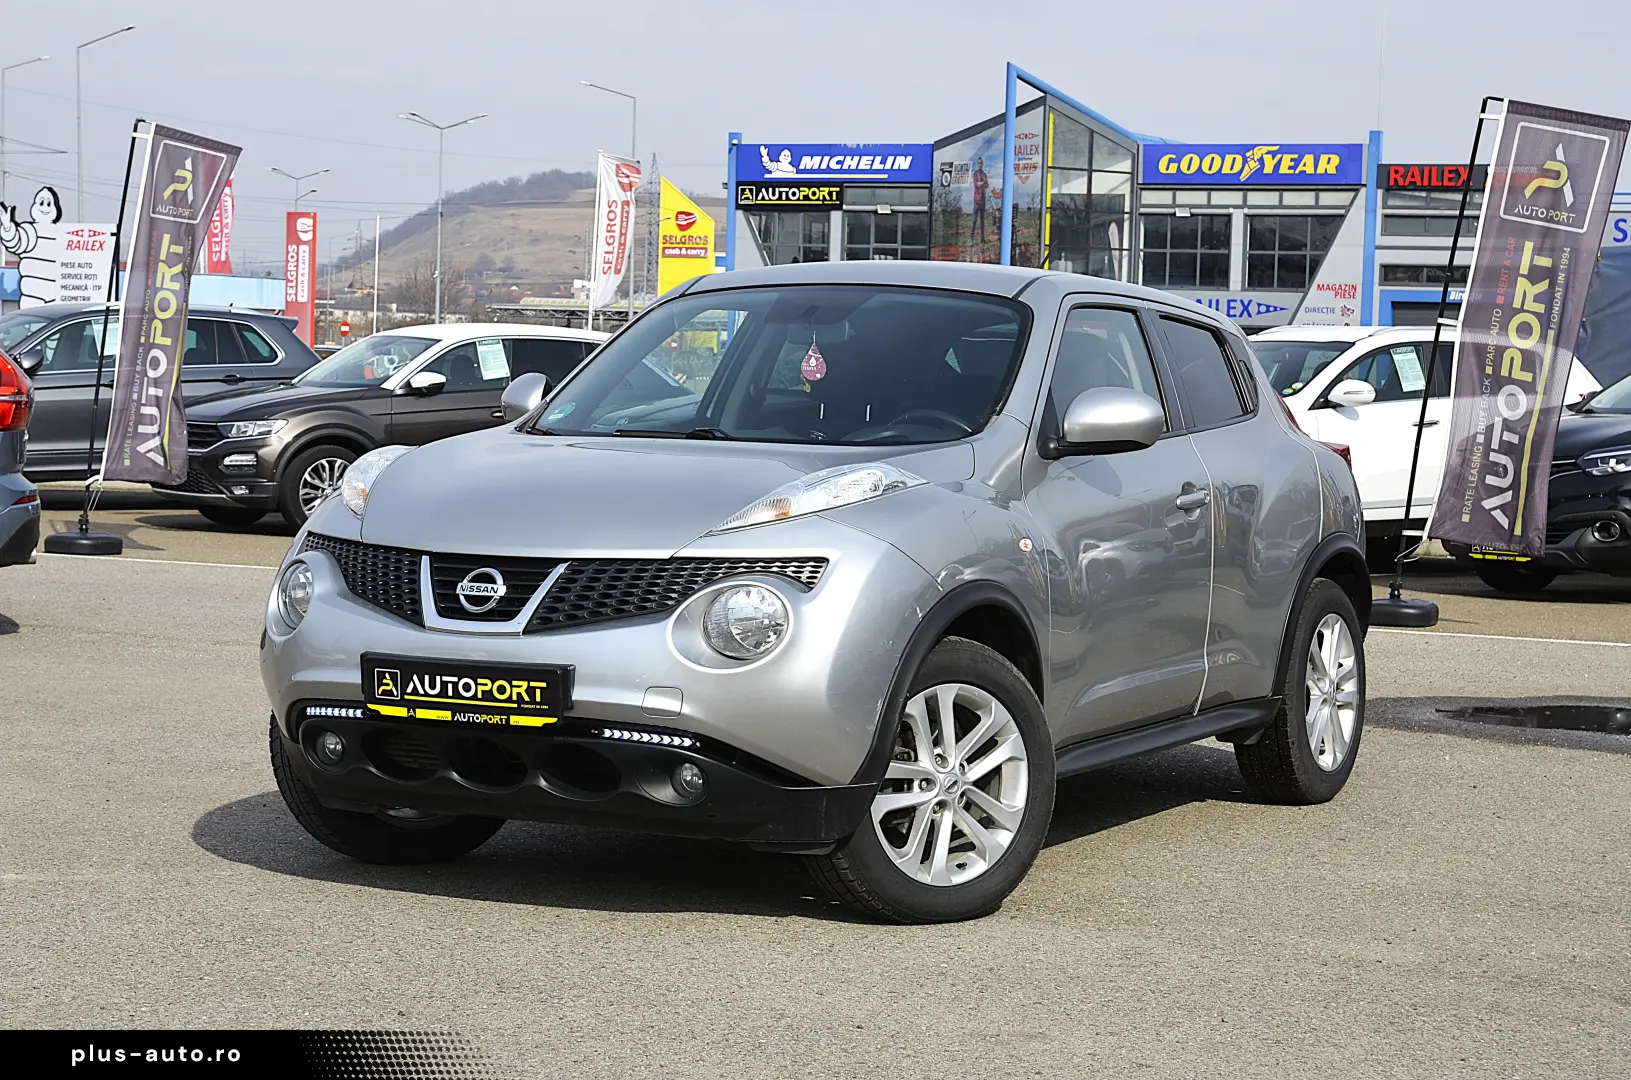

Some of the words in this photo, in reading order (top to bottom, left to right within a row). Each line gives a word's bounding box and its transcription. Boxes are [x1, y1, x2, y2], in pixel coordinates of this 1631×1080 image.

[799, 155, 913, 170] MICHELIN
[1389, 165, 1473, 187] RAILEX
[757, 187, 840, 200] AUTOPORT
[66, 240, 106, 251] RAILEX
[602, 200, 618, 275] SELGROS
[662, 234, 709, 246] SELGROS
[664, 247, 681, 255] cash
[687, 248, 706, 257] carry
[1560, 247, 1571, 270] 1994
[287, 244, 298, 302] SELGROS
[1499, 269, 1511, 295] RENT
[1505, 237, 1516, 258] CAR
[1556, 271, 1566, 284] IN
[1316, 283, 1357, 292] MAGAZIN
[1334, 291, 1357, 299] PIESE
[1550, 287, 1561, 329] FONDAT
[140, 315, 149, 336] PARC
[1490, 308, 1502, 337] AUTO
[136, 233, 184, 467] AUTOPORT
[136, 346, 144, 371] BACK
[1485, 339, 1496, 366] PARC
[133, 374, 142, 392] BUY
[1481, 240, 1553, 531] AUTOPORT
[1481, 377, 1492, 408] BACK
[127, 402, 137, 436] LEASING
[1477, 409, 1488, 434] BUY
[123, 436, 132, 459] RATE
[1462, 488, 1476, 515] RATE
[1469, 445, 1483, 488] LEASING
[458, 584, 499, 595] NISSAN
[406, 673, 547, 702] AUTOPORT
[454, 712, 508, 725] AUTOPORT
